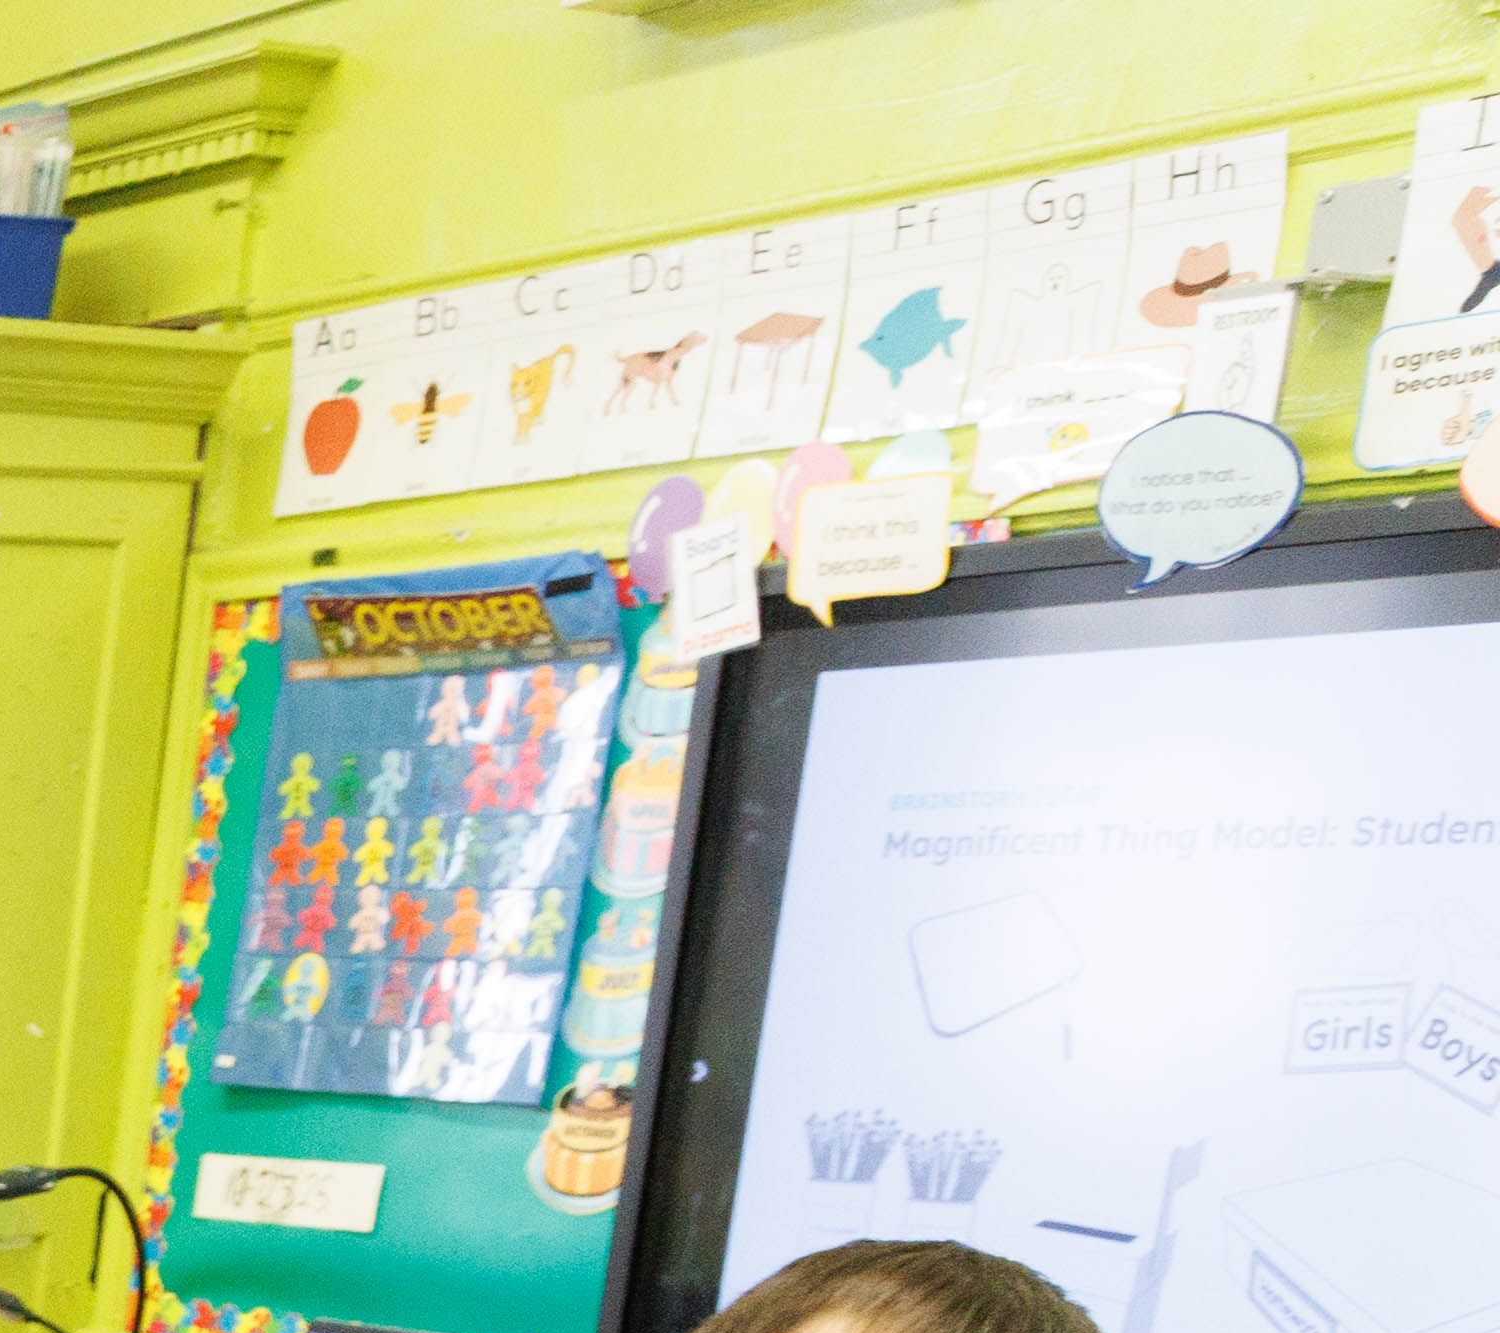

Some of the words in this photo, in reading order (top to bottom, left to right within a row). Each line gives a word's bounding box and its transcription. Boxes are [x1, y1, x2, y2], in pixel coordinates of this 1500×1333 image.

[1168, 150, 1235, 202] Hh
[1022, 178, 1087, 231] Gg
[893, 204, 940, 251] Ff
[750, 231, 804, 275] Ee
[629, 253, 684, 295] Dd
[514, 276, 572, 316] Cc
[413, 298, 460, 337] Bb
[1212, 306, 1280, 331] RESTROOM
[311, 320, 357, 358] Aa
[1380, 355, 1388, 371] I
[1393, 345, 1463, 375] agree
[1393, 366, 1495, 396] because
[1140, 470, 1194, 488] notice
[1199, 467, 1235, 485] that
[1151, 496, 1174, 515] do
[1179, 497, 1212, 517] you
[1215, 489, 1286, 510] notice?
[685, 527, 741, 558] Board
[833, 523, 879, 542] think
[884, 519, 920, 536] this
[817, 555, 903, 577] because
[354, 592, 554, 647] OCTOBER
[881, 824, 1084, 866] Magnificent
[1096, 820, 1199, 861] Thing
[1211, 816, 1339, 852] Model:
[1301, 1016, 1395, 1054] Girls
[1418, 1016, 1500, 1084] Boys
